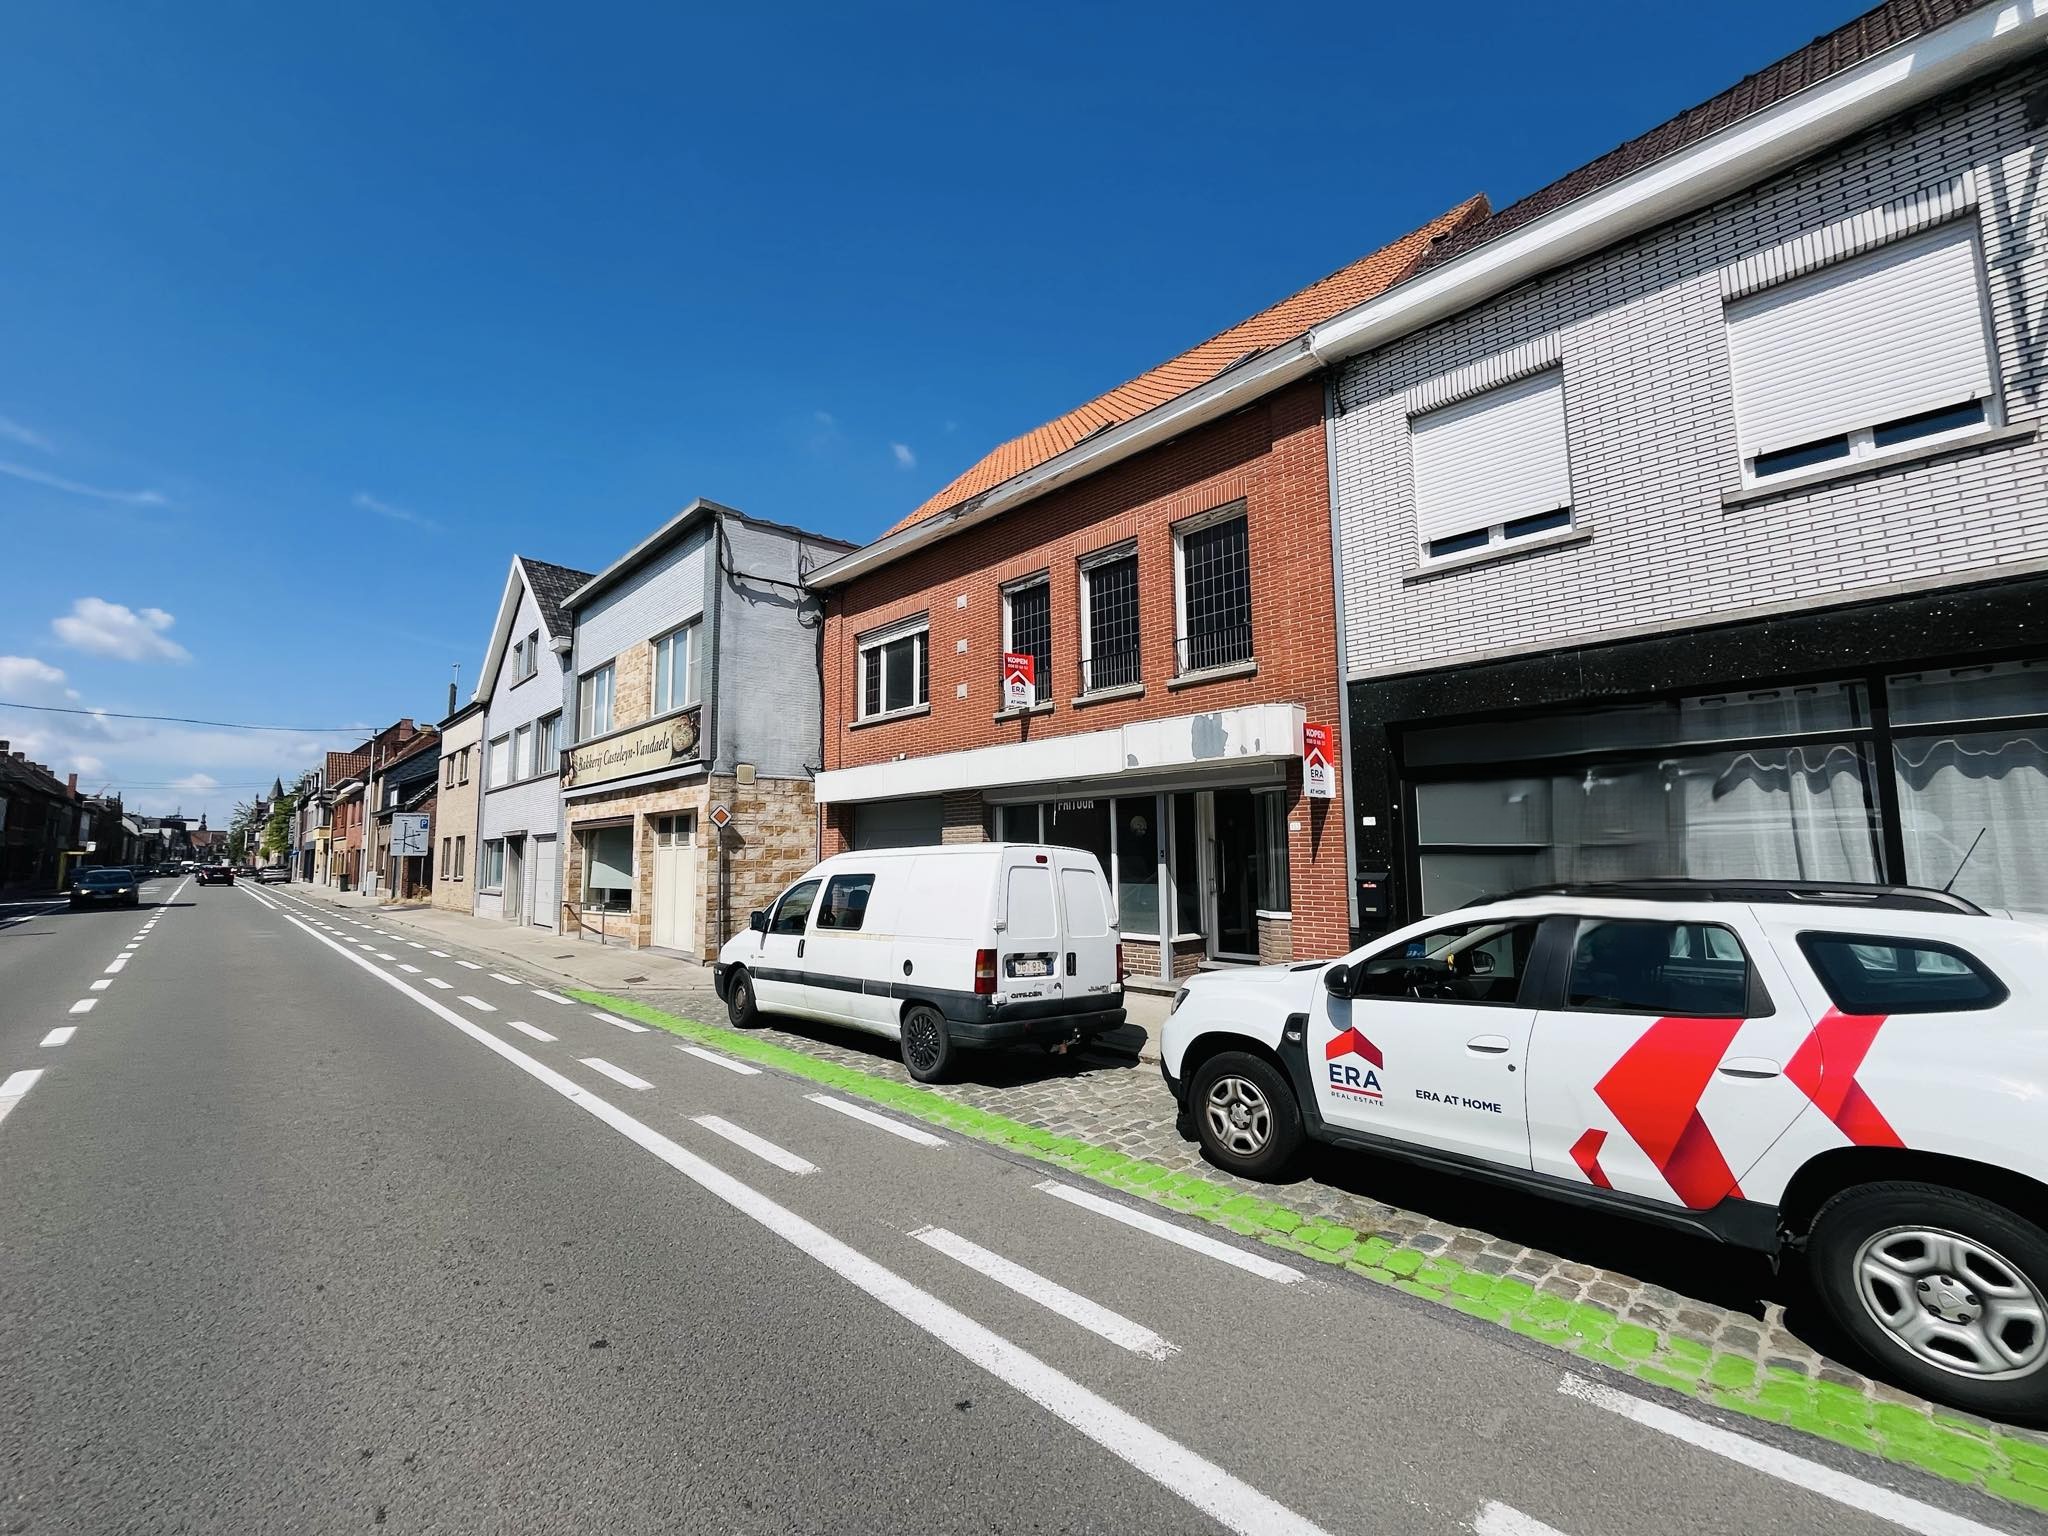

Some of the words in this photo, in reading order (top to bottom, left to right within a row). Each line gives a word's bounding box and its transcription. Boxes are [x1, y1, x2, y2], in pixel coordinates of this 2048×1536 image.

[1007, 656, 1029, 665] KOPEN
[1011, 686, 1026, 694] ERA
[1306, 728, 1326, 739] KOPEN
[578, 753, 603, 772] Bakkerij
[1310, 769, 1324, 779] ERA
[1329, 1063, 1382, 1091] ERA
[1331, 1091, 1351, 1100] REAL
[1353, 1095, 1385, 1107] ESTATE
[1415, 1089, 1441, 1102] ERA
[1443, 1094, 1459, 1105] AT
[1462, 1098, 1502, 1113] HOME
